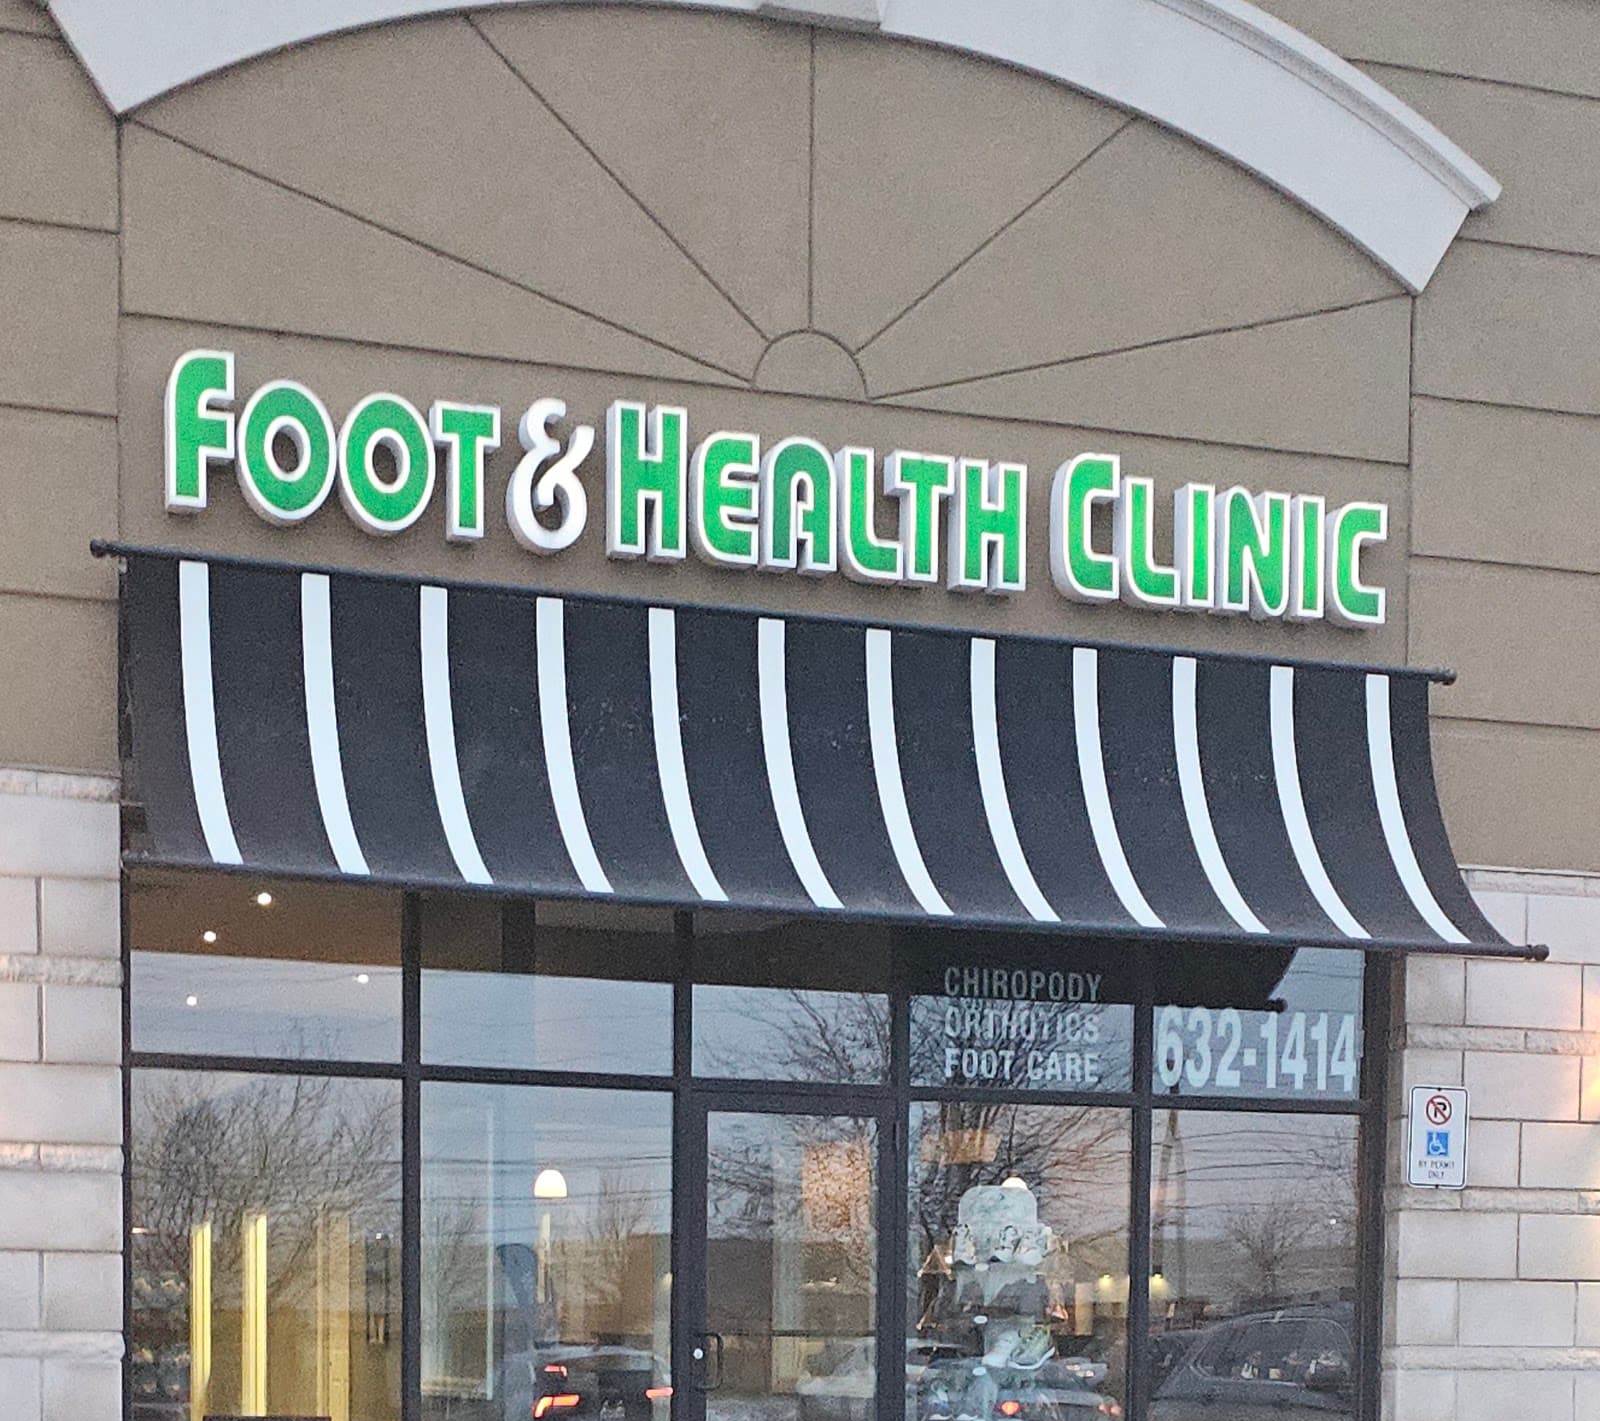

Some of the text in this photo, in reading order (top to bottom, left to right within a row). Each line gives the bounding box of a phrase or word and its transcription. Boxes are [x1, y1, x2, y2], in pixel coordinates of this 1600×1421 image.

[165, 350, 1388, 628] FOOT & HEALTH CLINIC
[944, 966, 1101, 1001] CHIROPODY
[944, 1005, 1100, 1043] ORTHOTICS
[944, 1047, 1100, 1083] FOOT CARE
[1157, 1005, 1357, 1092] 632-1414
